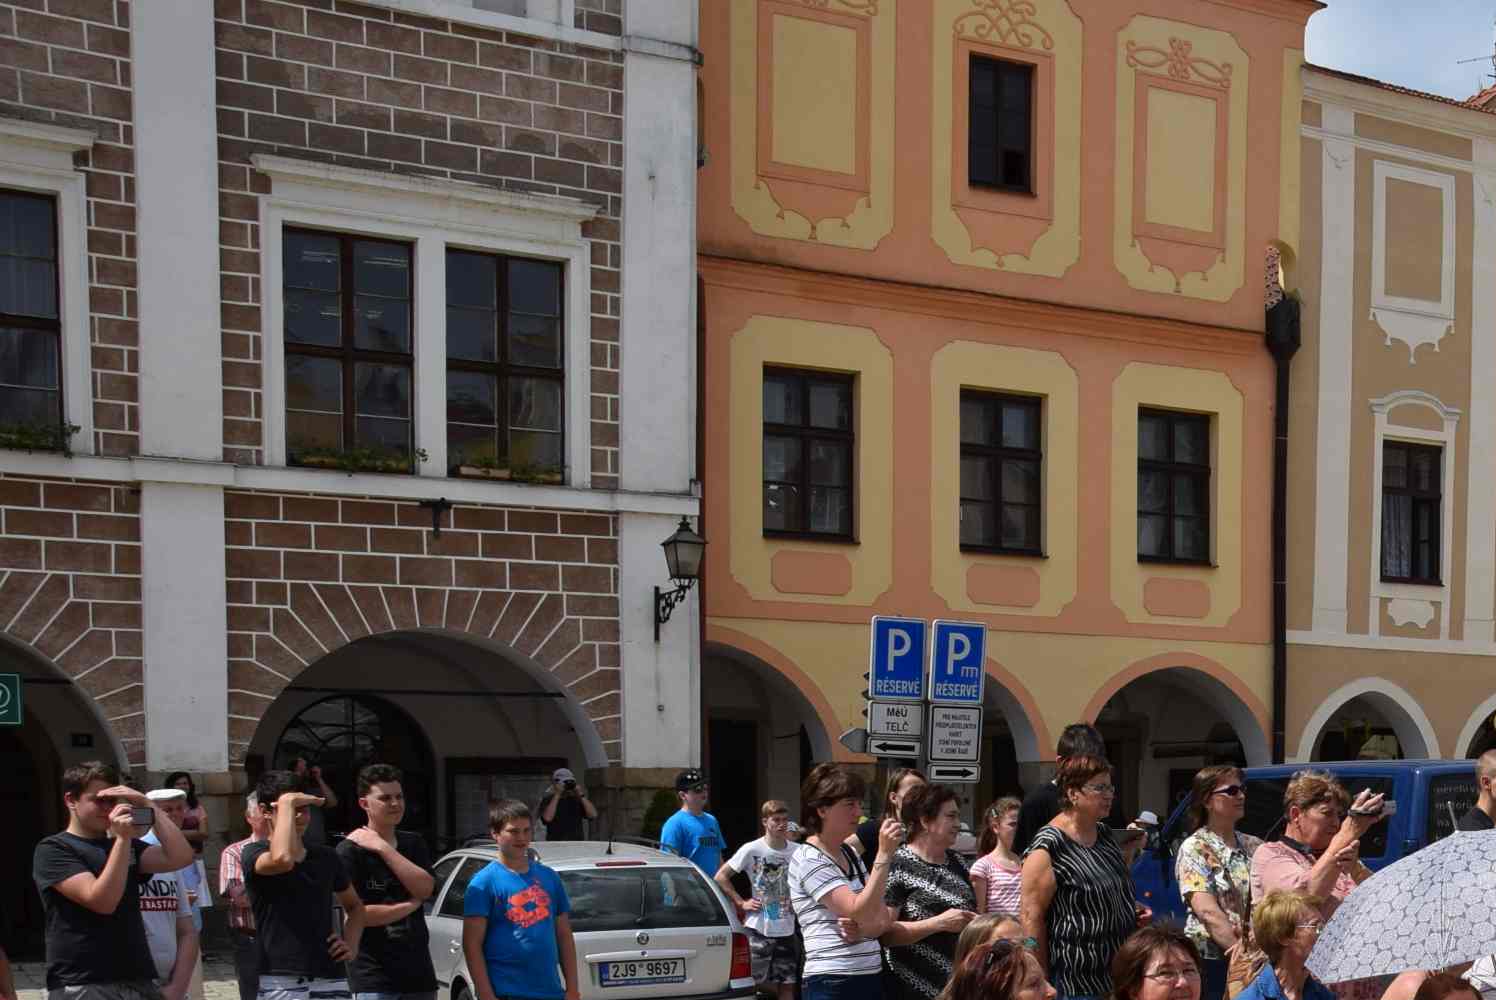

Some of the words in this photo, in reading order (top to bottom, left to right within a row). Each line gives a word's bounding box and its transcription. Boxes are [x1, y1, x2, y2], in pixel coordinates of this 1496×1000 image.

[887, 628, 912, 672] P
[947, 632, 971, 675] P
[886, 720, 910, 732] TELČ
[612, 963, 637, 978] 2J9
[646, 961, 678, 976] 9697
